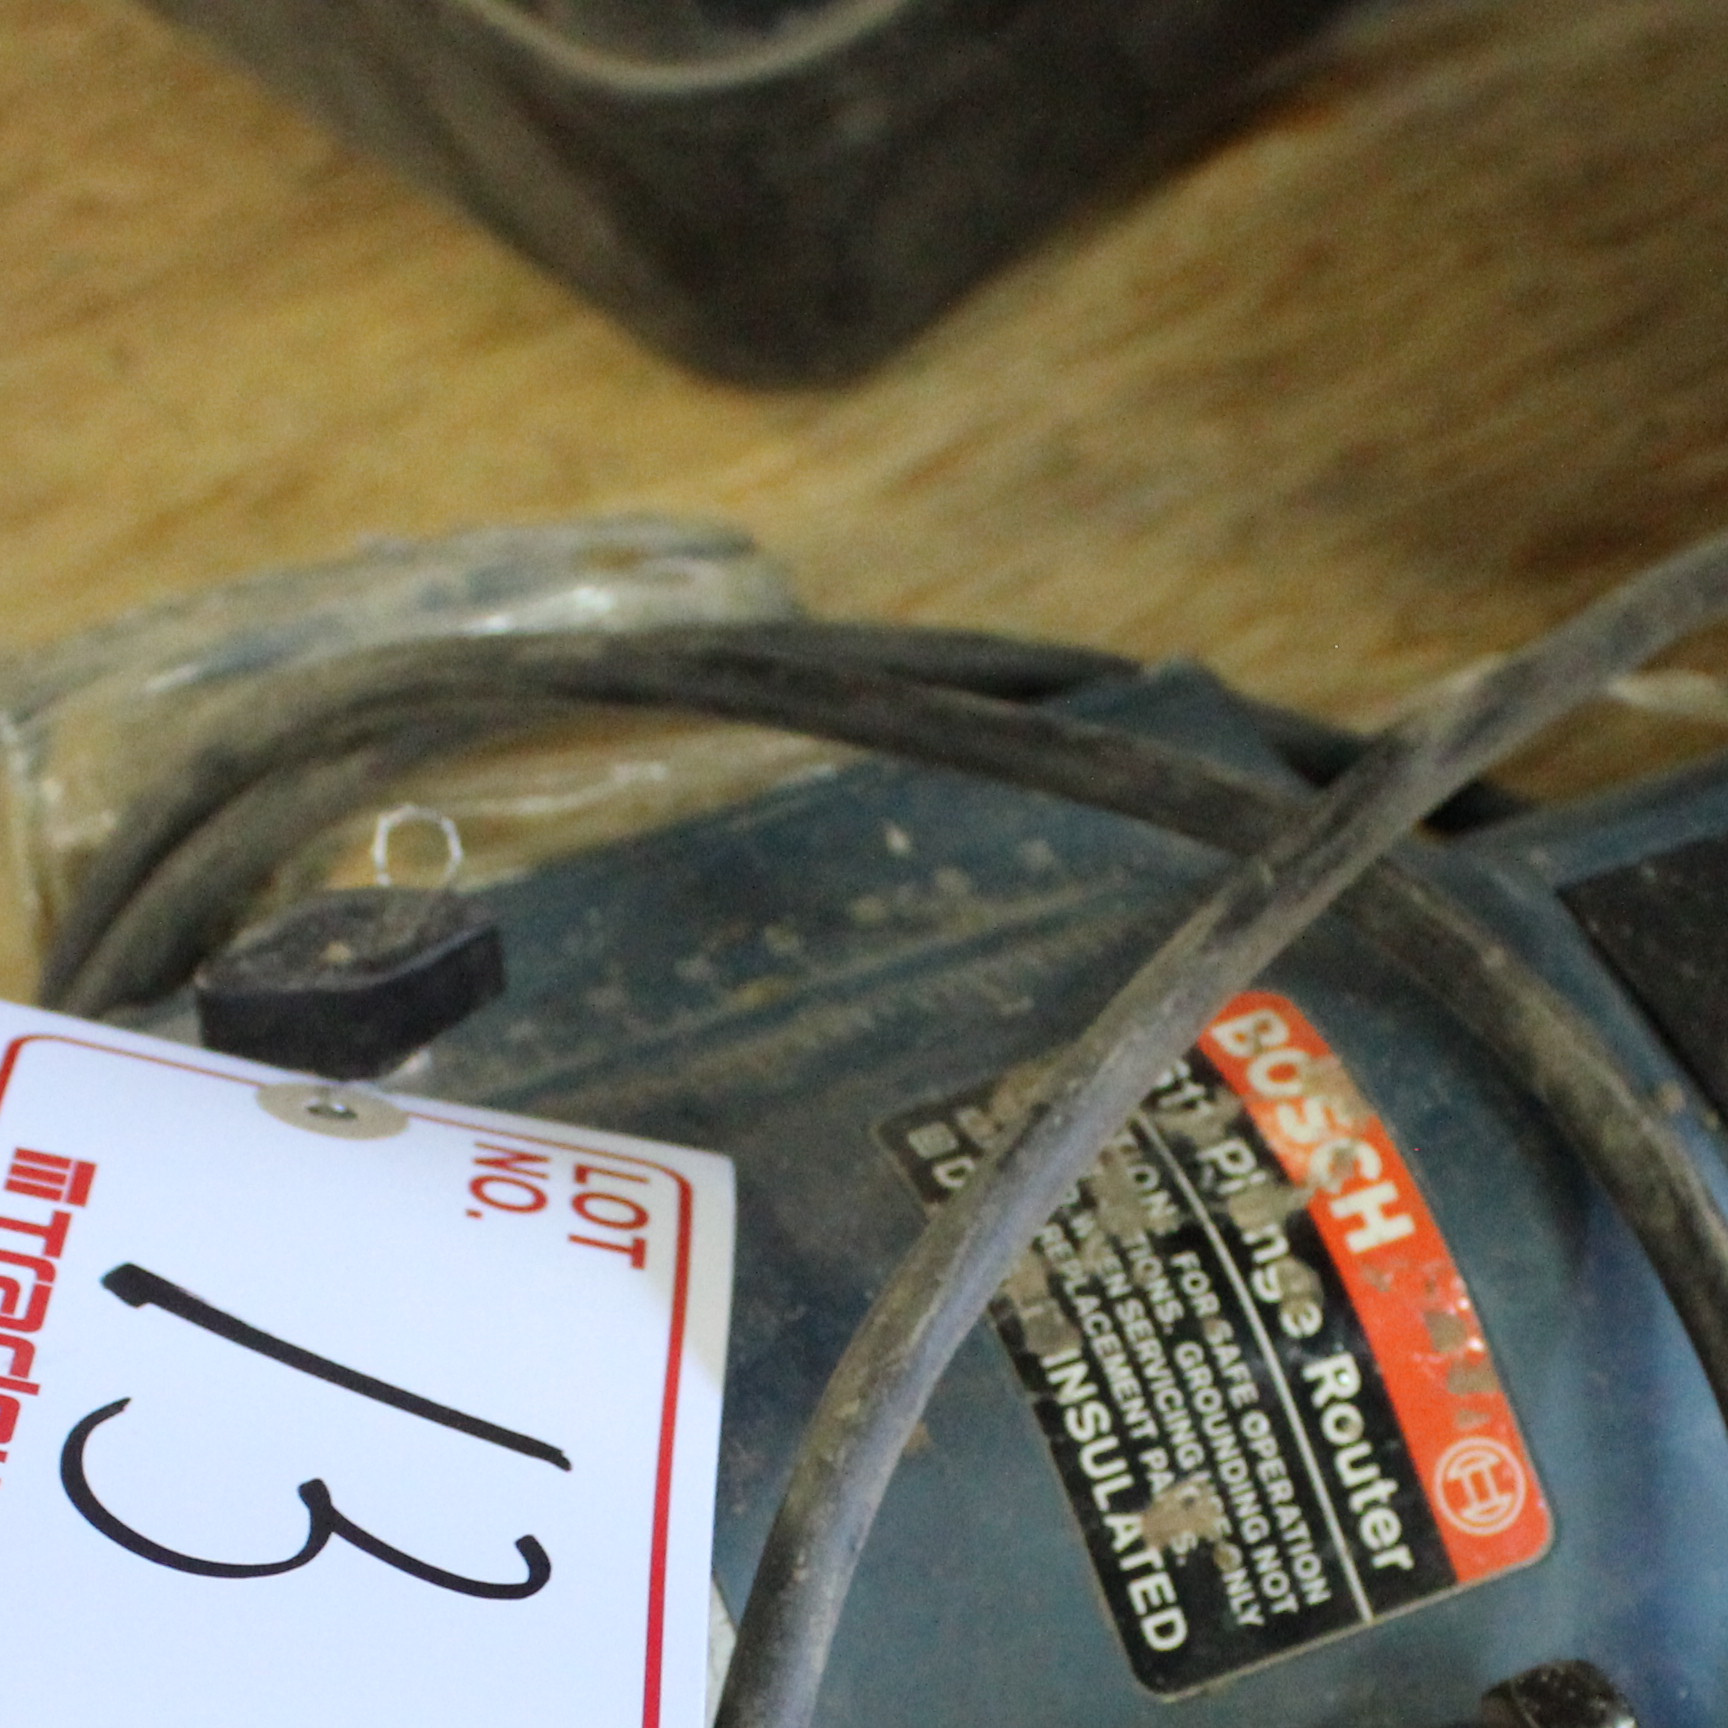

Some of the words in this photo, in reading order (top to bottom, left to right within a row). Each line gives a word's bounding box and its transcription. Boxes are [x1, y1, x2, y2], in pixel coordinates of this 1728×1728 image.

[466, 1142, 551, 1219] NO.
[568, 1163, 650, 1269] LOT
[1211, 1009, 1415, 1255] BOSCH
[59, 1261, 573, 1600] 13
[1041, 1223, 1159, 1439] REPLACEMENT
[1115, 1298, 1205, 1471] SERVICING
[1170, 1252, 1221, 1318] FOR
[1203, 1319, 1260, 1409] SAFE
[1241, 1409, 1332, 1606] OPERATION
[1196, 1137, 1326, 1341] Plnge
[1303, 1353, 1413, 1575] Router
[1040, 1349, 1188, 1652] INSULATED
[1175, 1341, 1270, 1544] GROUNDING
[1251, 1544, 1299, 1615] NOT
